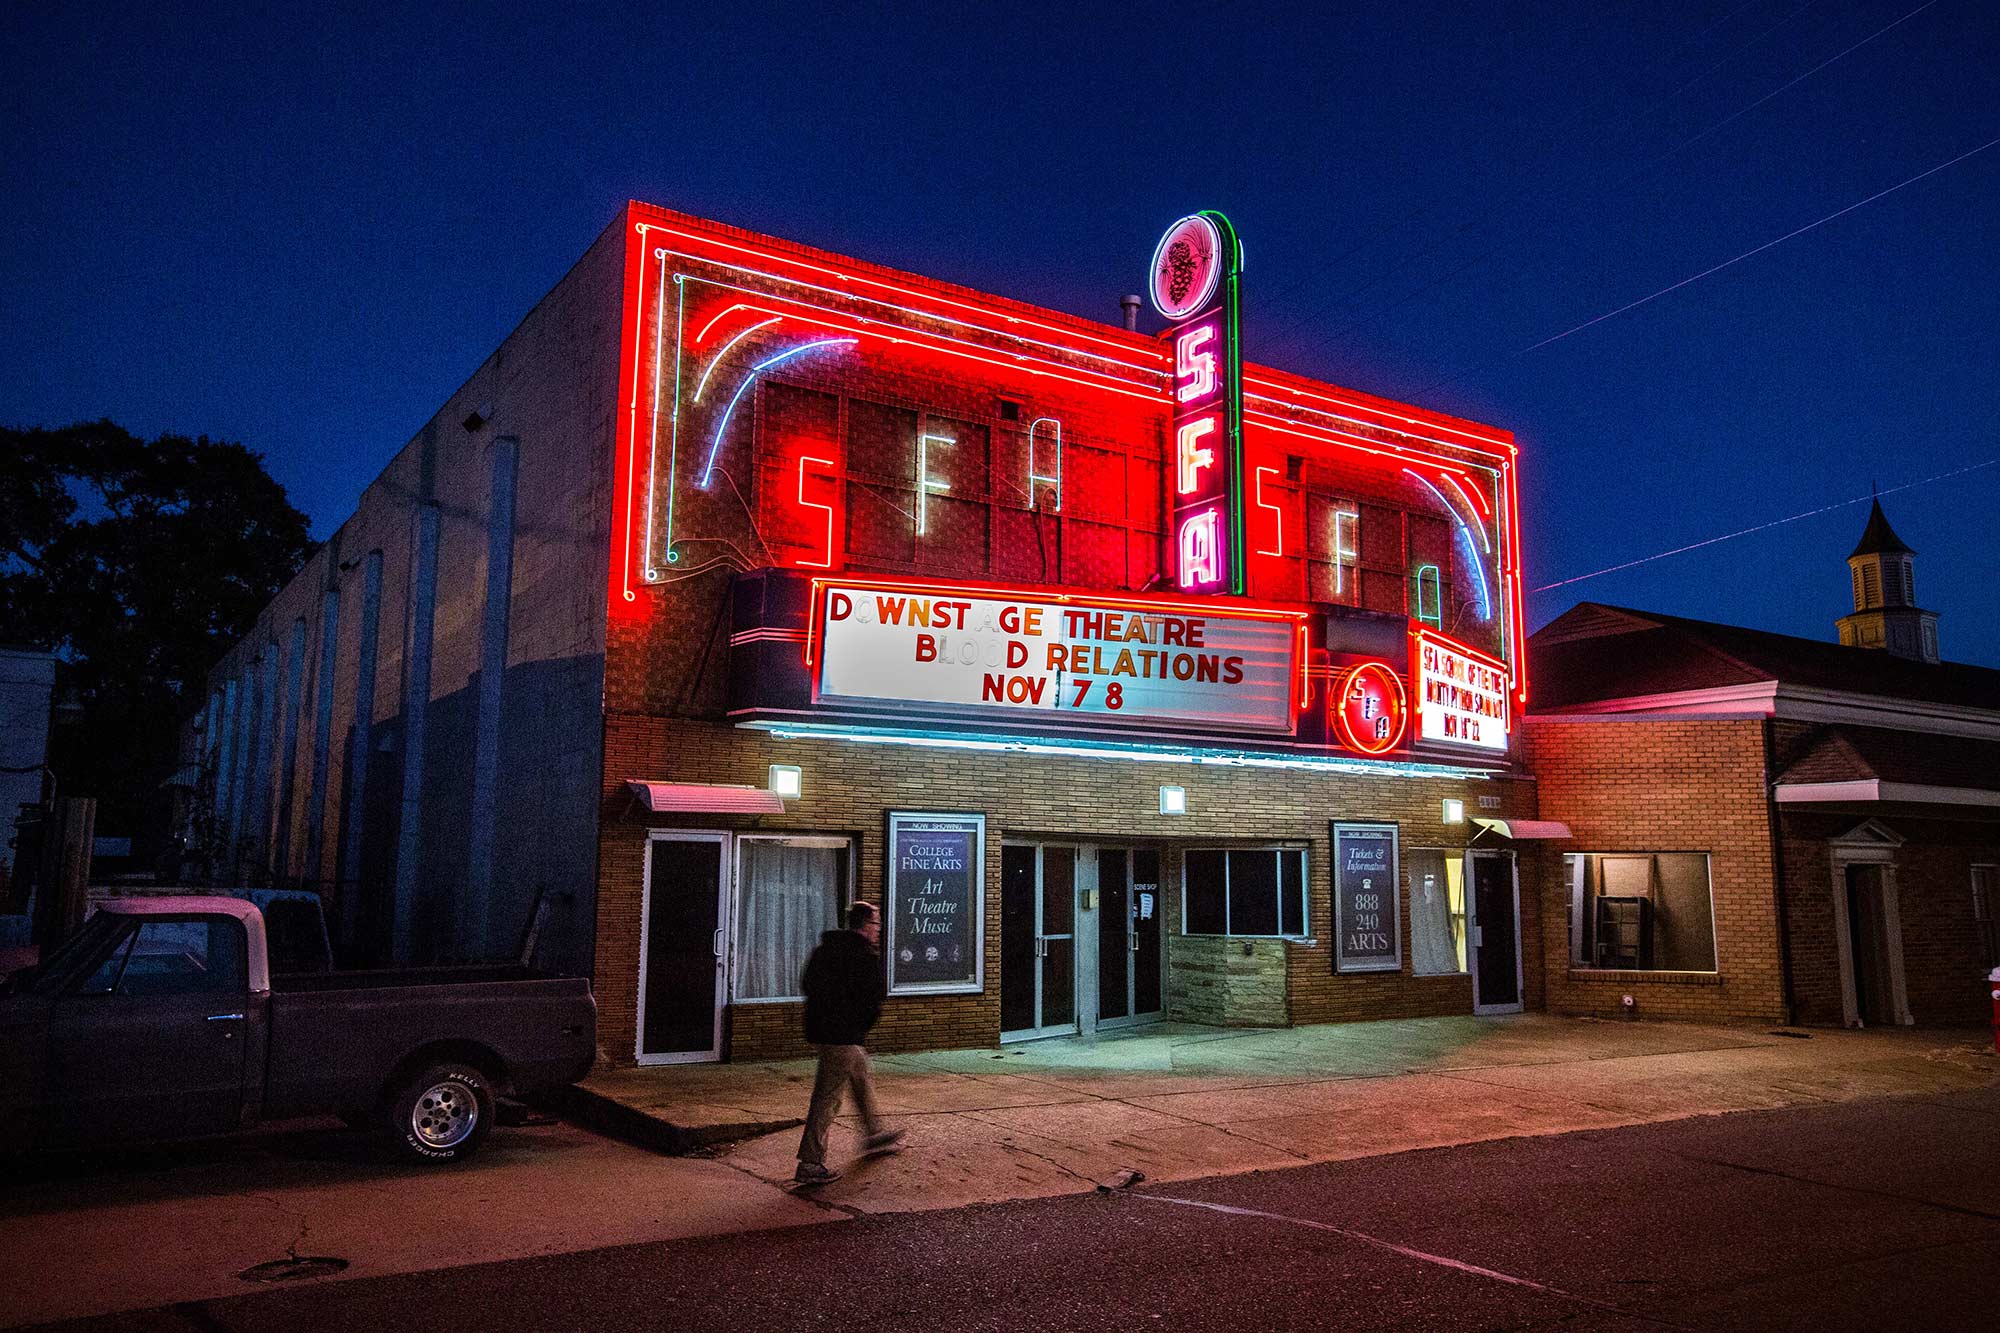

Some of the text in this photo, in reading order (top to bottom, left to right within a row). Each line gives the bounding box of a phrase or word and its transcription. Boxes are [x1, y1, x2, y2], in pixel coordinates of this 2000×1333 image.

[1064, 610, 1206, 649] THEATRE
[915, 634, 1244, 684] BLOOD RELATIONS
[982, 674, 1124, 711] NOV 7 8
[909, 845, 955, 857] COLLEGE
[1349, 847, 1384, 859] Tickets &
[902, 857, 962, 870] FINE ARTS
[1347, 860, 1386, 874] Information
[920, 877, 944, 895] Art
[907, 897, 958, 915] Theatre
[1355, 893, 1379, 911] 888
[910, 917, 953, 935] Music
[1355, 913, 1379, 930] 240
[1348, 933, 1388, 950] ARTS
[449, 1073, 480, 1088] KELLY
[406, 1134, 455, 1158] CHARGER
